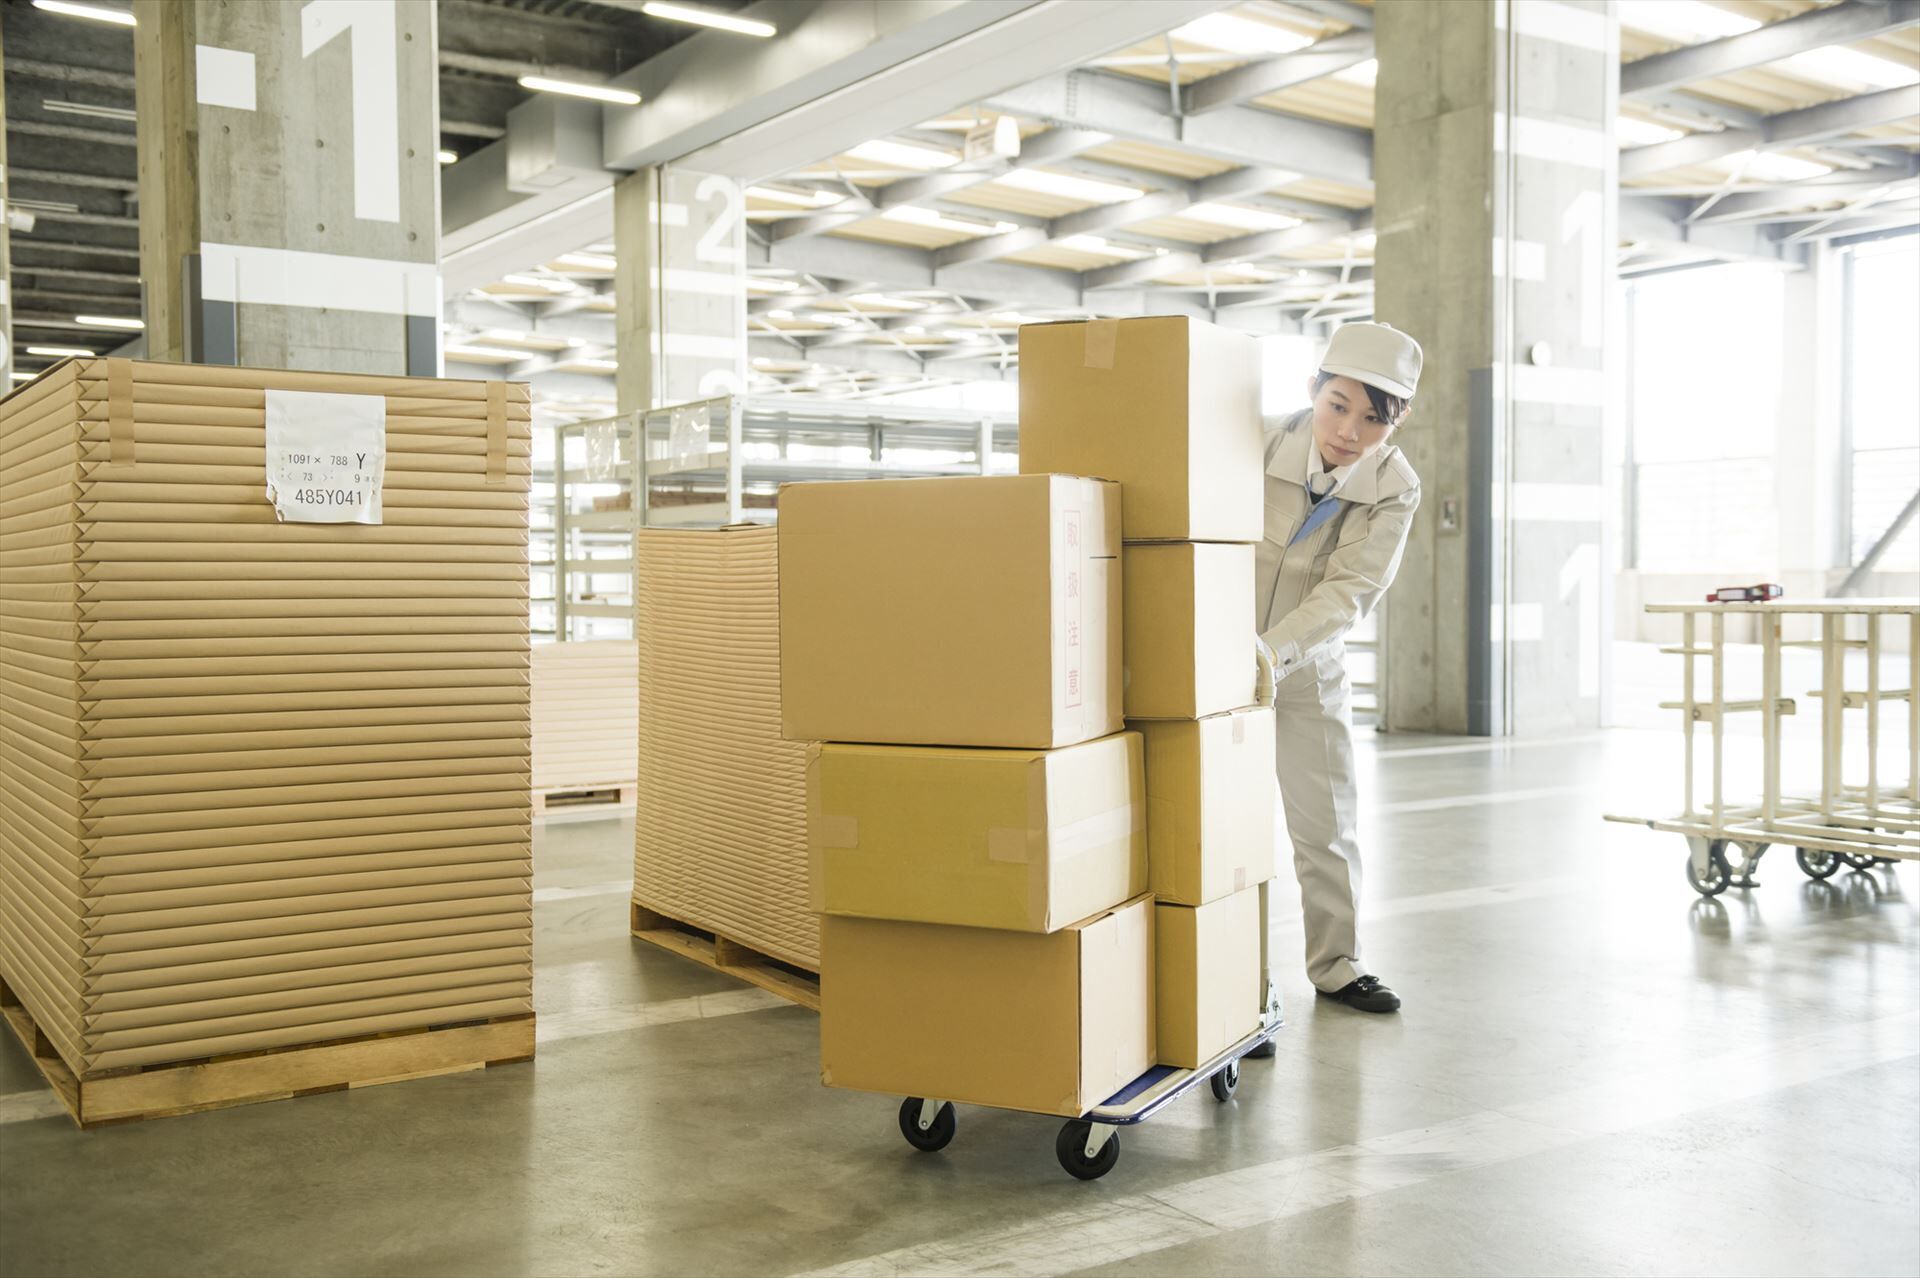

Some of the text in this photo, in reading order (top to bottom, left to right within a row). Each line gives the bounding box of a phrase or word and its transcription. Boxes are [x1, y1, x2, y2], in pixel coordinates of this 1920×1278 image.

[288, 454, 310, 464] 1091
[330, 456, 348, 465] 788
[356, 453, 366, 469] Y
[303, 472, 313, 481] 73
[295, 489, 362, 505] 485Y041
